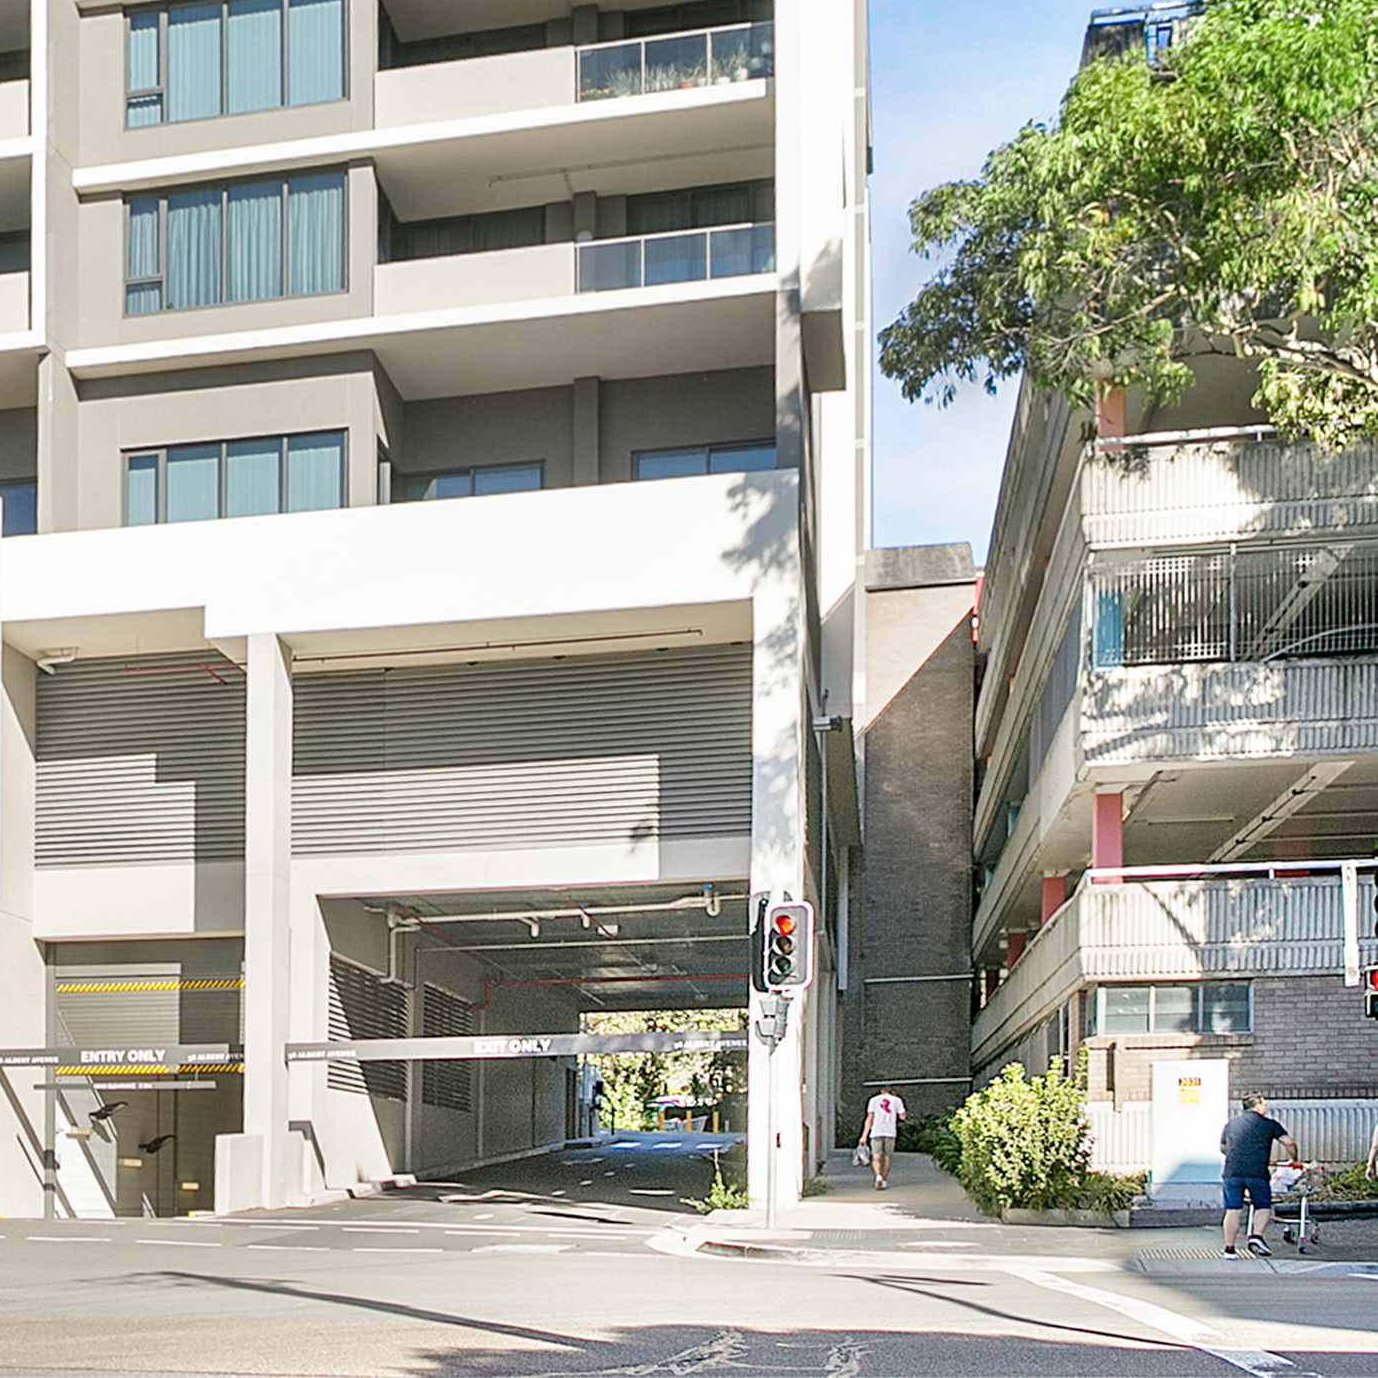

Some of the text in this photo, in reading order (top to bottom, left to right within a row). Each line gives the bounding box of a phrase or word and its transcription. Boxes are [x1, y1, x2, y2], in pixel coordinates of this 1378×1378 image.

[473, 1038, 552, 1055] EXIT ONLY
[80, 1049, 166, 1063] ENTRY ONLY
